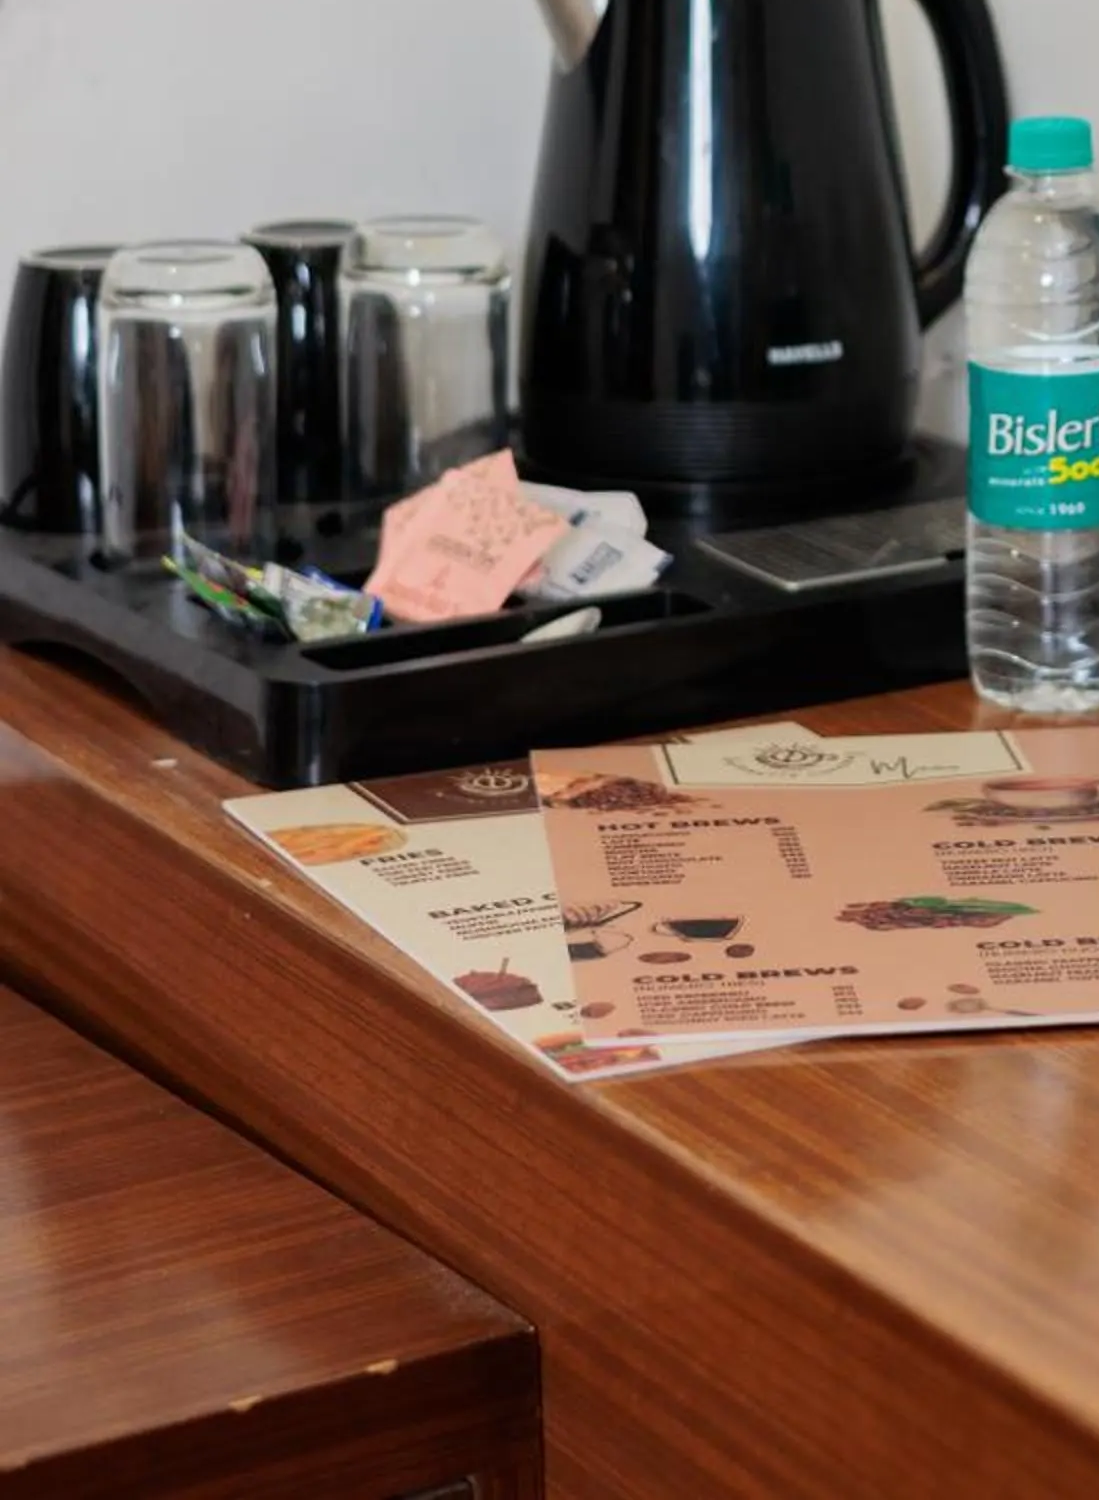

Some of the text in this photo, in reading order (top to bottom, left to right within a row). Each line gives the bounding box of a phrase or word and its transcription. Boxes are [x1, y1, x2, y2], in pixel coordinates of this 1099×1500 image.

[598, 817, 780, 831] HOT BREWS
[932, 839, 1017, 849] COLD
[359, 849, 443, 866] FRIES
[428, 897, 533, 919] BAKED
[976, 938, 1065, 949] COLD
[632, 966, 858, 984] COLD BREWS
